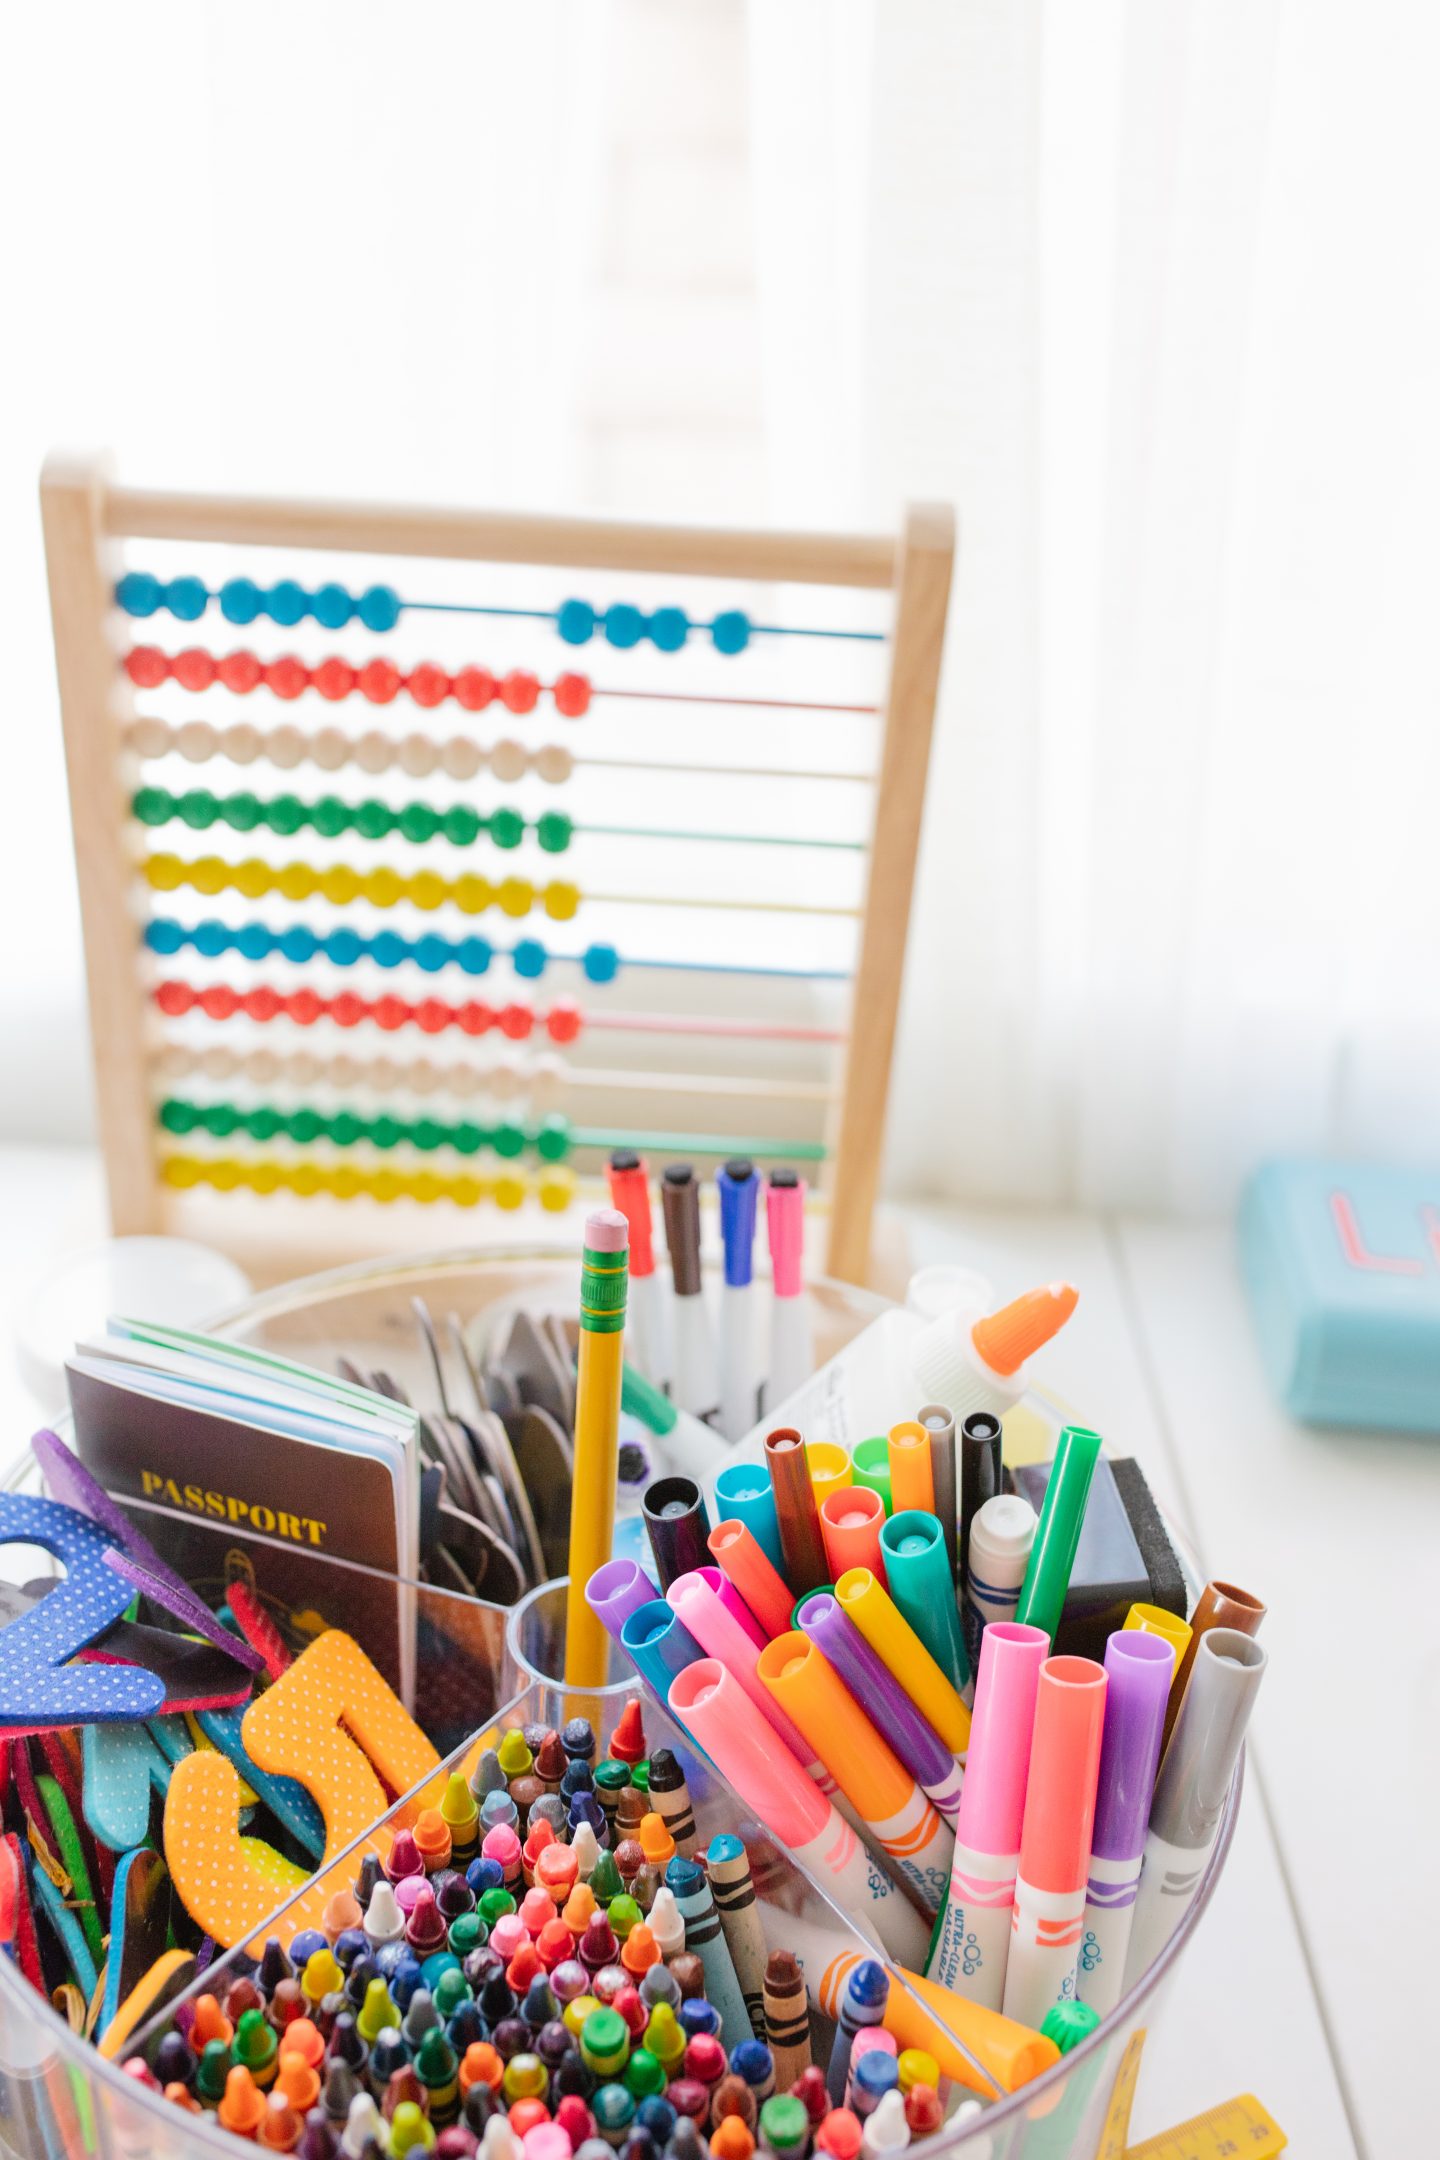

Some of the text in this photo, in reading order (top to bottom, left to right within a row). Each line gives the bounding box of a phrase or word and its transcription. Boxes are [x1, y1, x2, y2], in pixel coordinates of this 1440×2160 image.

[141, 1470, 327, 1545] PASSPORT
[938, 1903, 953, 1981] WASHABLE
[945, 1908, 965, 1990] ULTRA-CLEAN
